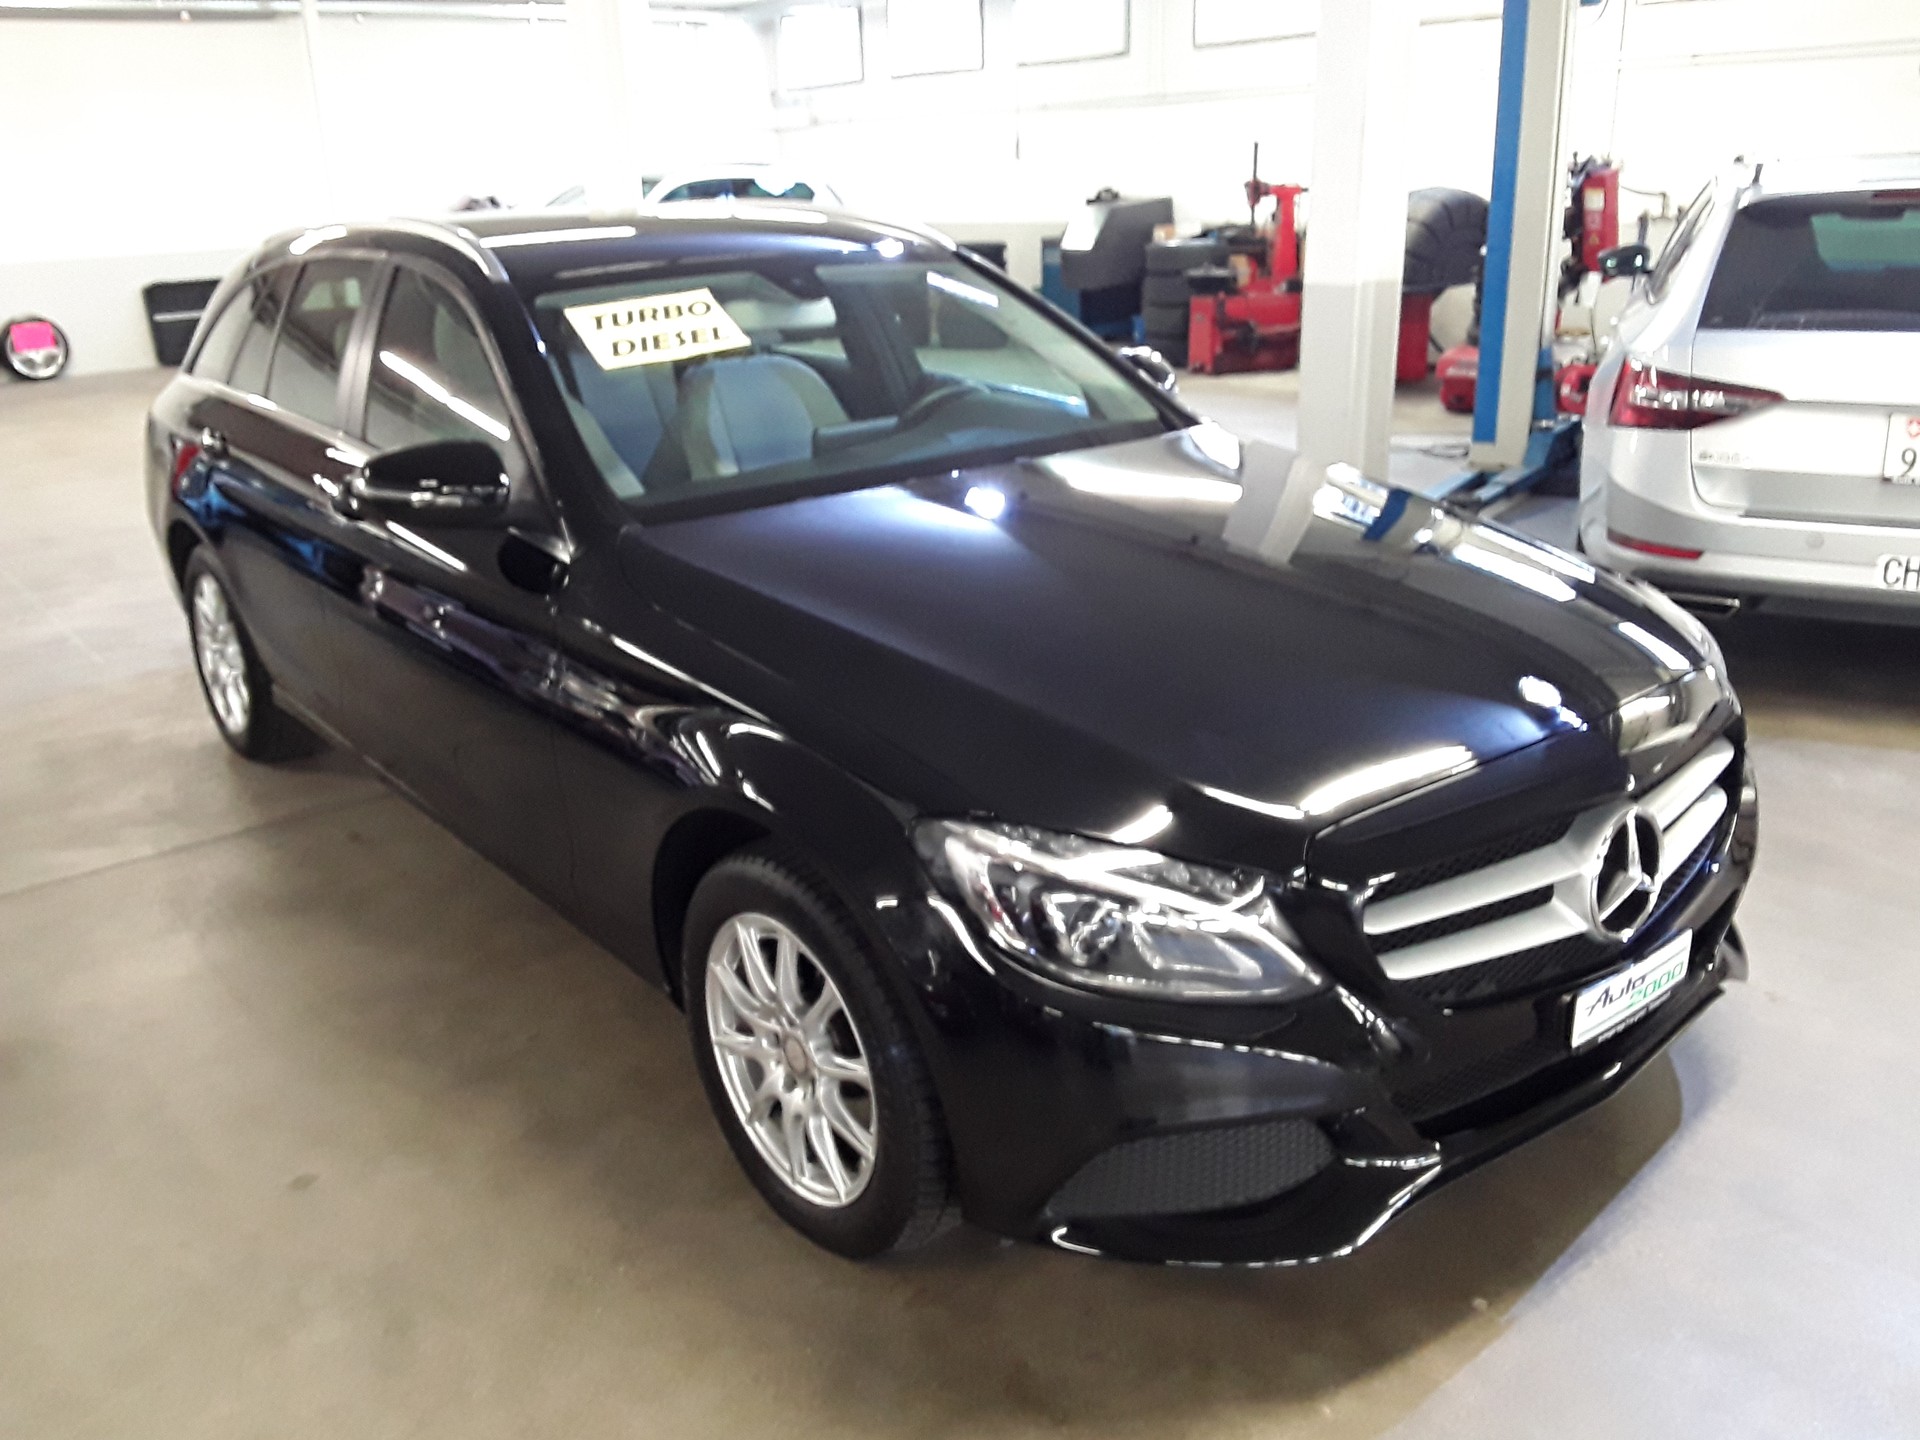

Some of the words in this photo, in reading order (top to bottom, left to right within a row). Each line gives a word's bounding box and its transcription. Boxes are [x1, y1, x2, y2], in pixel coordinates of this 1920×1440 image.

[593, 301, 711, 330] TURBO
[612, 327, 729, 357] DIESEL
[1585, 974, 1647, 1017] Auto
[1626, 960, 1684, 1009] 2000
